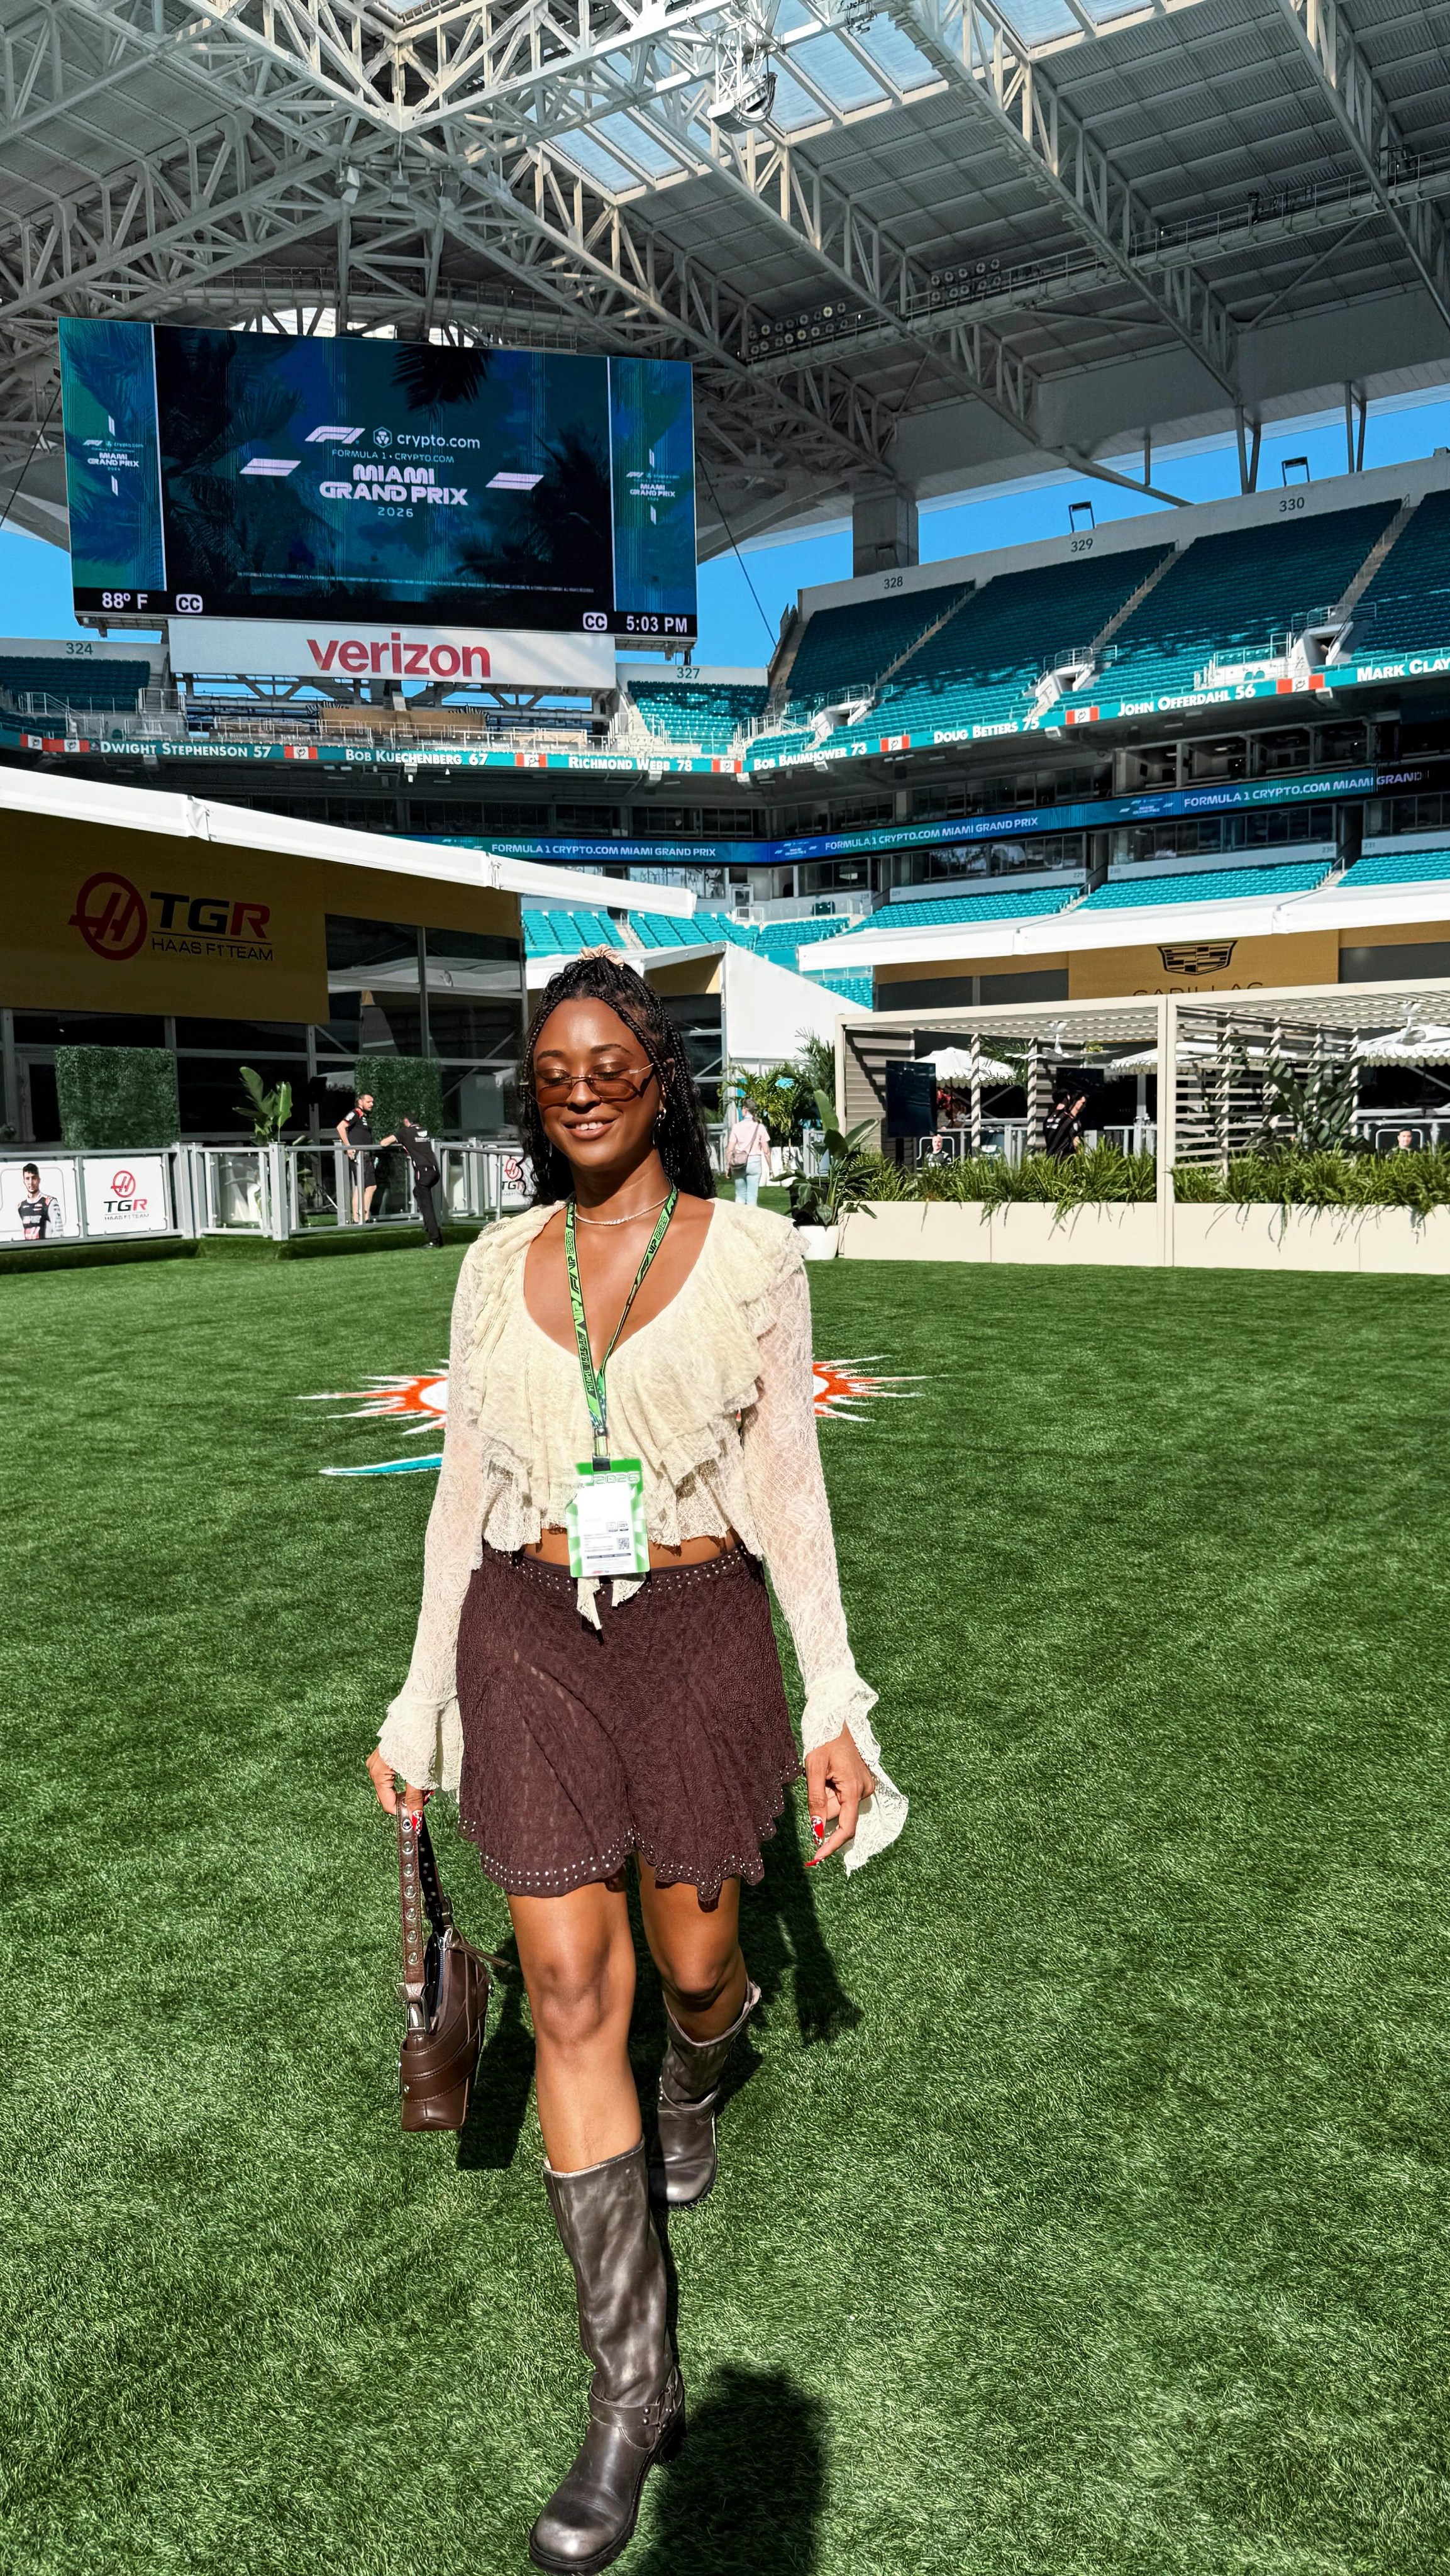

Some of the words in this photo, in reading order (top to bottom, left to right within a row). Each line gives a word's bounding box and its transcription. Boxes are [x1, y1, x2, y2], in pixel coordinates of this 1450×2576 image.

[397, 434, 480, 449] crypto.com
[87, 458, 118, 466] GRAND
[332, 449, 379, 459] FORMULA
[394, 453, 455, 464] CRYPTO.COM
[353, 464, 435, 485] MIAMI
[319, 481, 407, 502] GRAND
[411, 486, 468, 506] PRIX
[1279, 497, 1305, 512] 330
[377, 507, 414, 518] 2026
[1071, 538, 1093, 553] 329
[884, 576, 903, 589] 328
[137, 594, 148, 609] F
[179, 597, 200, 611] CC
[585, 615, 606, 629] CC
[626, 616, 659, 631] 5:03
[665, 618, 688, 633] PM
[66, 642, 93, 655] 324
[307, 632, 491, 679] verizon
[677, 667, 700, 680] 327
[1357, 664, 1405, 682] MARK
[1117, 701, 1154, 717] JOHN
[1158, 689, 1231, 711] OFFERDAHL
[1235, 684, 1256, 699] 56
[934, 730, 968, 744] DOUG
[972, 723, 1018, 738] BETTERS
[1022, 717, 1039, 731] 75
[101, 740, 157, 754] DWIGHT
[162, 741, 248, 757] STEPHENSON
[253, 744, 272, 758] 57
[346, 748, 372, 762] BOB
[376, 749, 462, 766] KUECHENBERG
[468, 753, 489, 766] 67
[568, 756, 633, 770] RICHMOND
[636, 757, 670, 771] WEBB
[677, 759, 692, 772] 78
[754, 757, 776, 771] BOB
[779, 748, 847, 767] BAUMHOWER
[851, 743, 868, 756] 73
[1184, 792, 1242, 807] FORMULA
[1244, 792, 1250, 802] 1
[1253, 782, 1331, 799] CRYPTO.COM
[1333, 777, 1373, 790] MIAMI
[1376, 772, 1422, 786] GRAND
[825, 838, 871, 850] FORMULA
[872, 835, 877, 845] 1
[878, 829, 940, 844] CRYPTO.COM
[942, 824, 973, 836] MIAMI
[976, 820, 1012, 833] GRAND
[1014, 817, 1039, 828] PRIX
[492, 844, 543, 853] FORMULA
[546, 845, 551, 853] 1
[553, 846, 618, 855] CRYPTO.COM
[620, 847, 653, 855] MIAMI
[655, 847, 691, 857] GRAND
[693, 848, 716, 857] PRIX
[150, 891, 270, 938] TGR
[152, 938, 202, 955] HAAS
[206, 944, 223, 957] F1
[225, 945, 274, 961] TEAM
[104, 1199, 148, 1213] TGR
[648, 1239, 658, 1254] VIP
[568, 1256, 576, 1270] VIP
[584, 1370, 595, 1391] MIAMI
